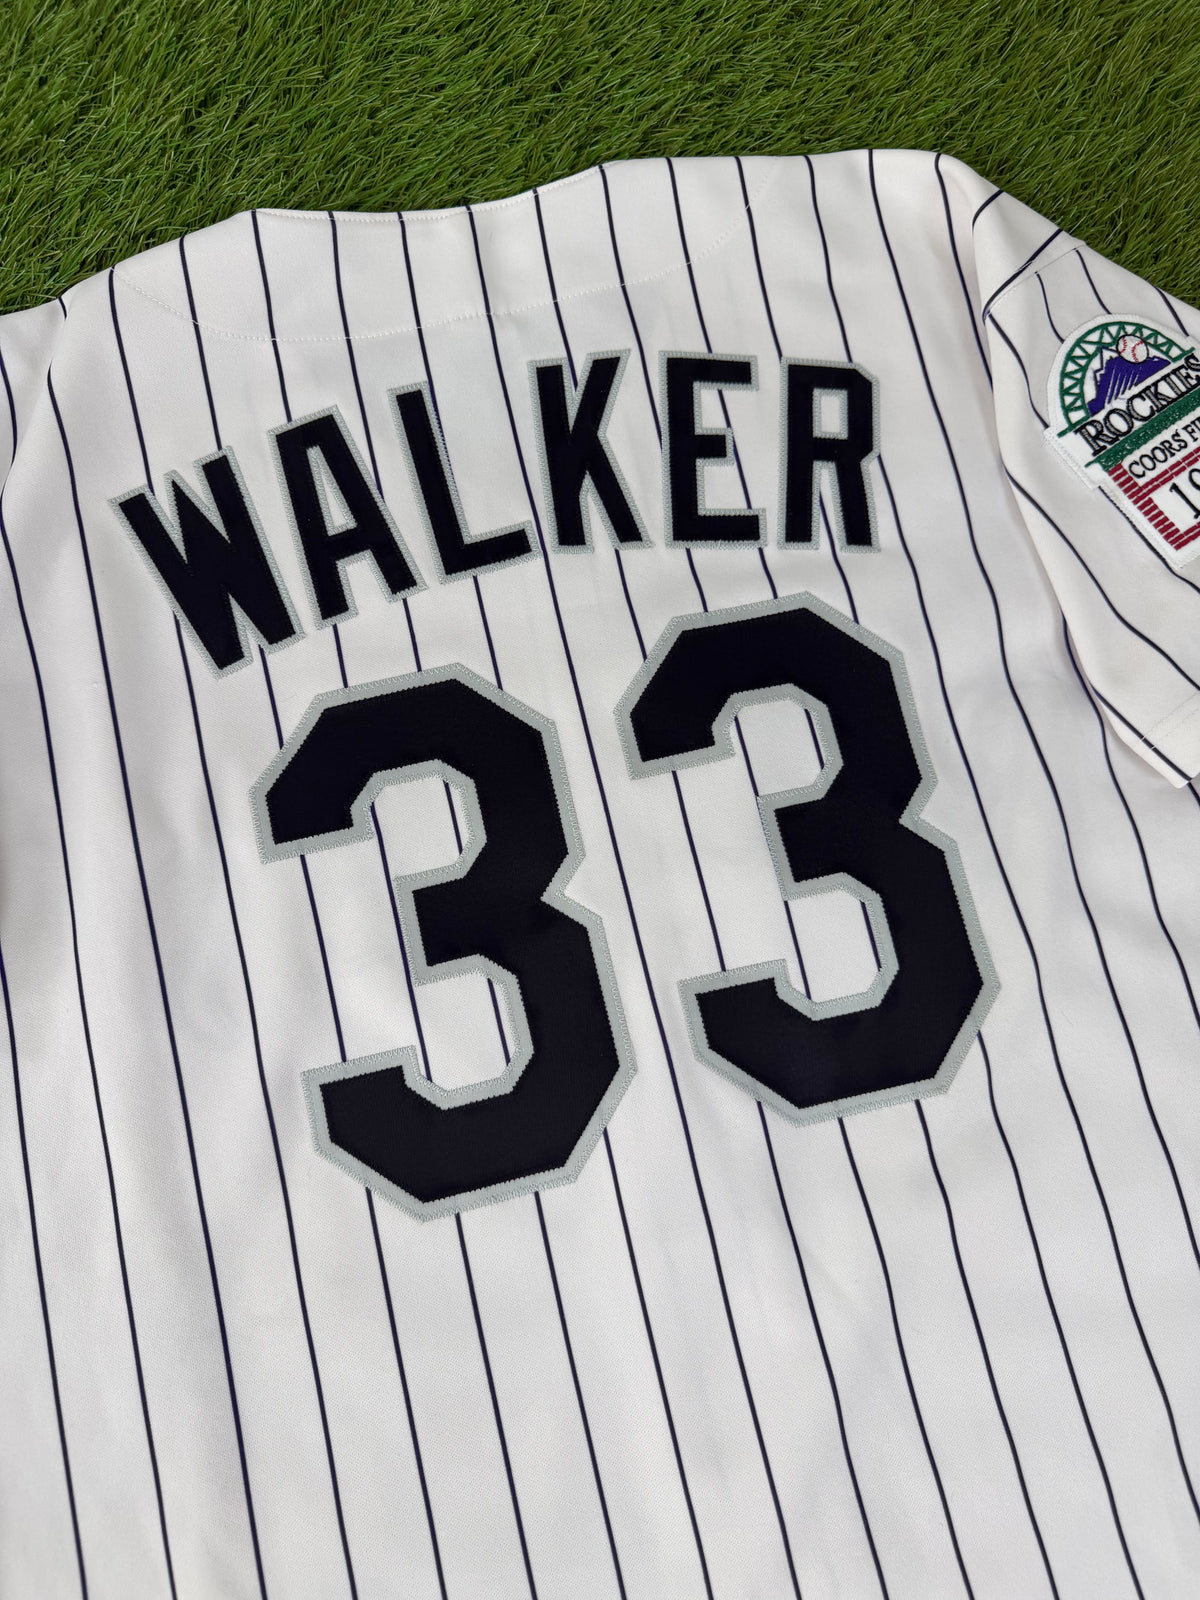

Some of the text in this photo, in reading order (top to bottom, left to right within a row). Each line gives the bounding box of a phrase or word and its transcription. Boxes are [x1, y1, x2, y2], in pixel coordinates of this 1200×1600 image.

[1074, 353, 1200, 457] ROCKIES
[1128, 429, 1188, 479] COORS
[109, 350, 881, 677] WALKER
[249, 592, 1001, 1222] 33
